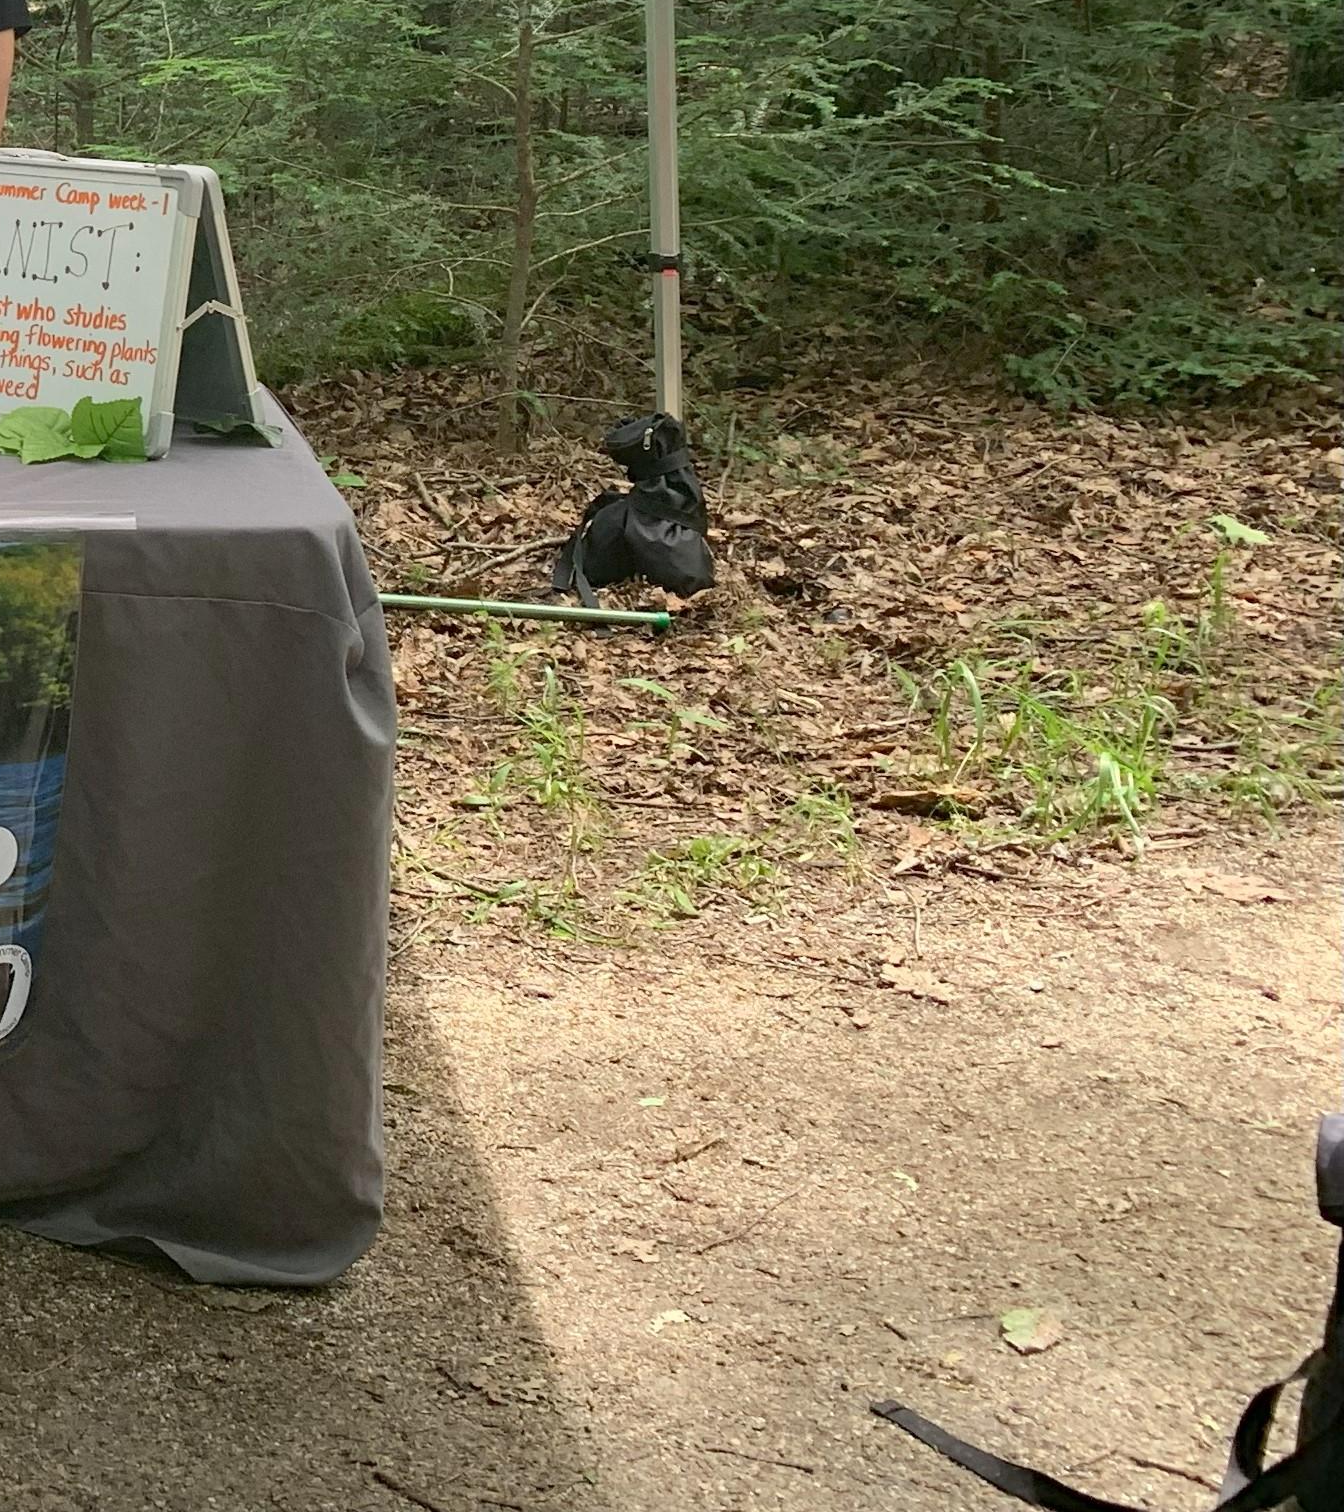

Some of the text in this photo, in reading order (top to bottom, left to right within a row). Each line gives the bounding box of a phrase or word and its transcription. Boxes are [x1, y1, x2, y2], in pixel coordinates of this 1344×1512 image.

[55, 182, 100, 215] Camp
[17, 297, 55, 322] who
[63, 303, 127, 330] studies
[25, 324, 107, 366] flowering
[109, 337, 158, 368] plants
[0, 346, 56, 378] things,
[63, 359, 103, 382] such
[110, 368, 130, 386] as
